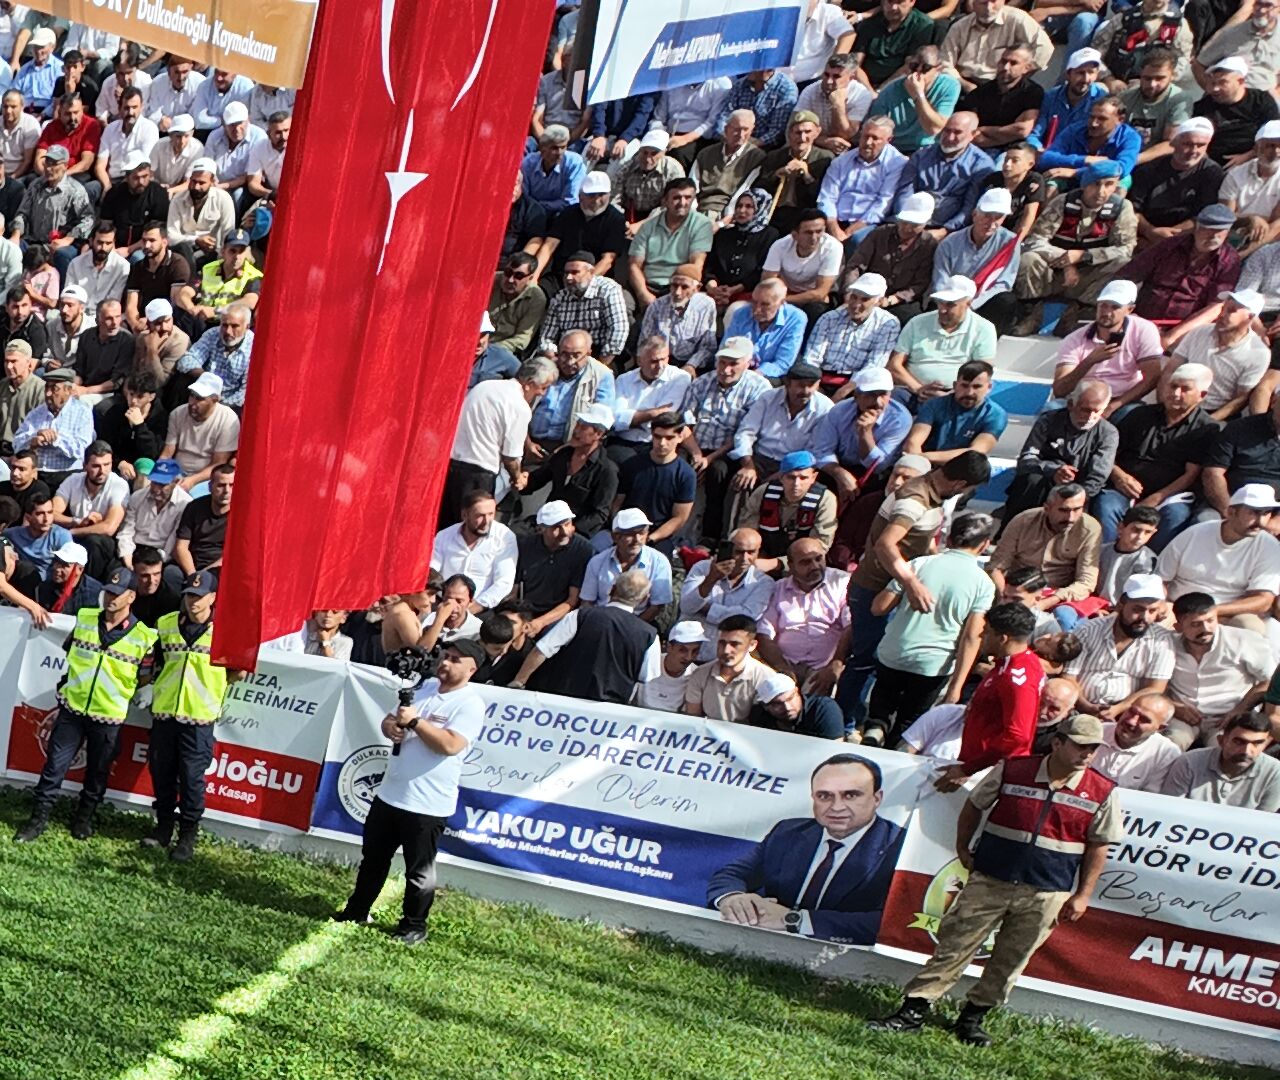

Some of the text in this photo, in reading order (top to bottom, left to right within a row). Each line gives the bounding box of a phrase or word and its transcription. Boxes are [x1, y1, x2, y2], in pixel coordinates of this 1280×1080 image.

[212, 20, 277, 63] Kaymakamı
[501, 704, 737, 763] SPORCULARIMIZA,
[527, 737, 554, 753] ve
[558, 734, 790, 796] İDARECİLERİMİZE
[218, 784, 257, 805] Kasap
[464, 806, 662, 866] YAKUP UĞUR
[518, 841, 578, 861] Muhtarlar
[579, 853, 623, 870] Dernek
[623, 861, 674, 881] Başkanı
[1197, 862, 1233, 880] ve
